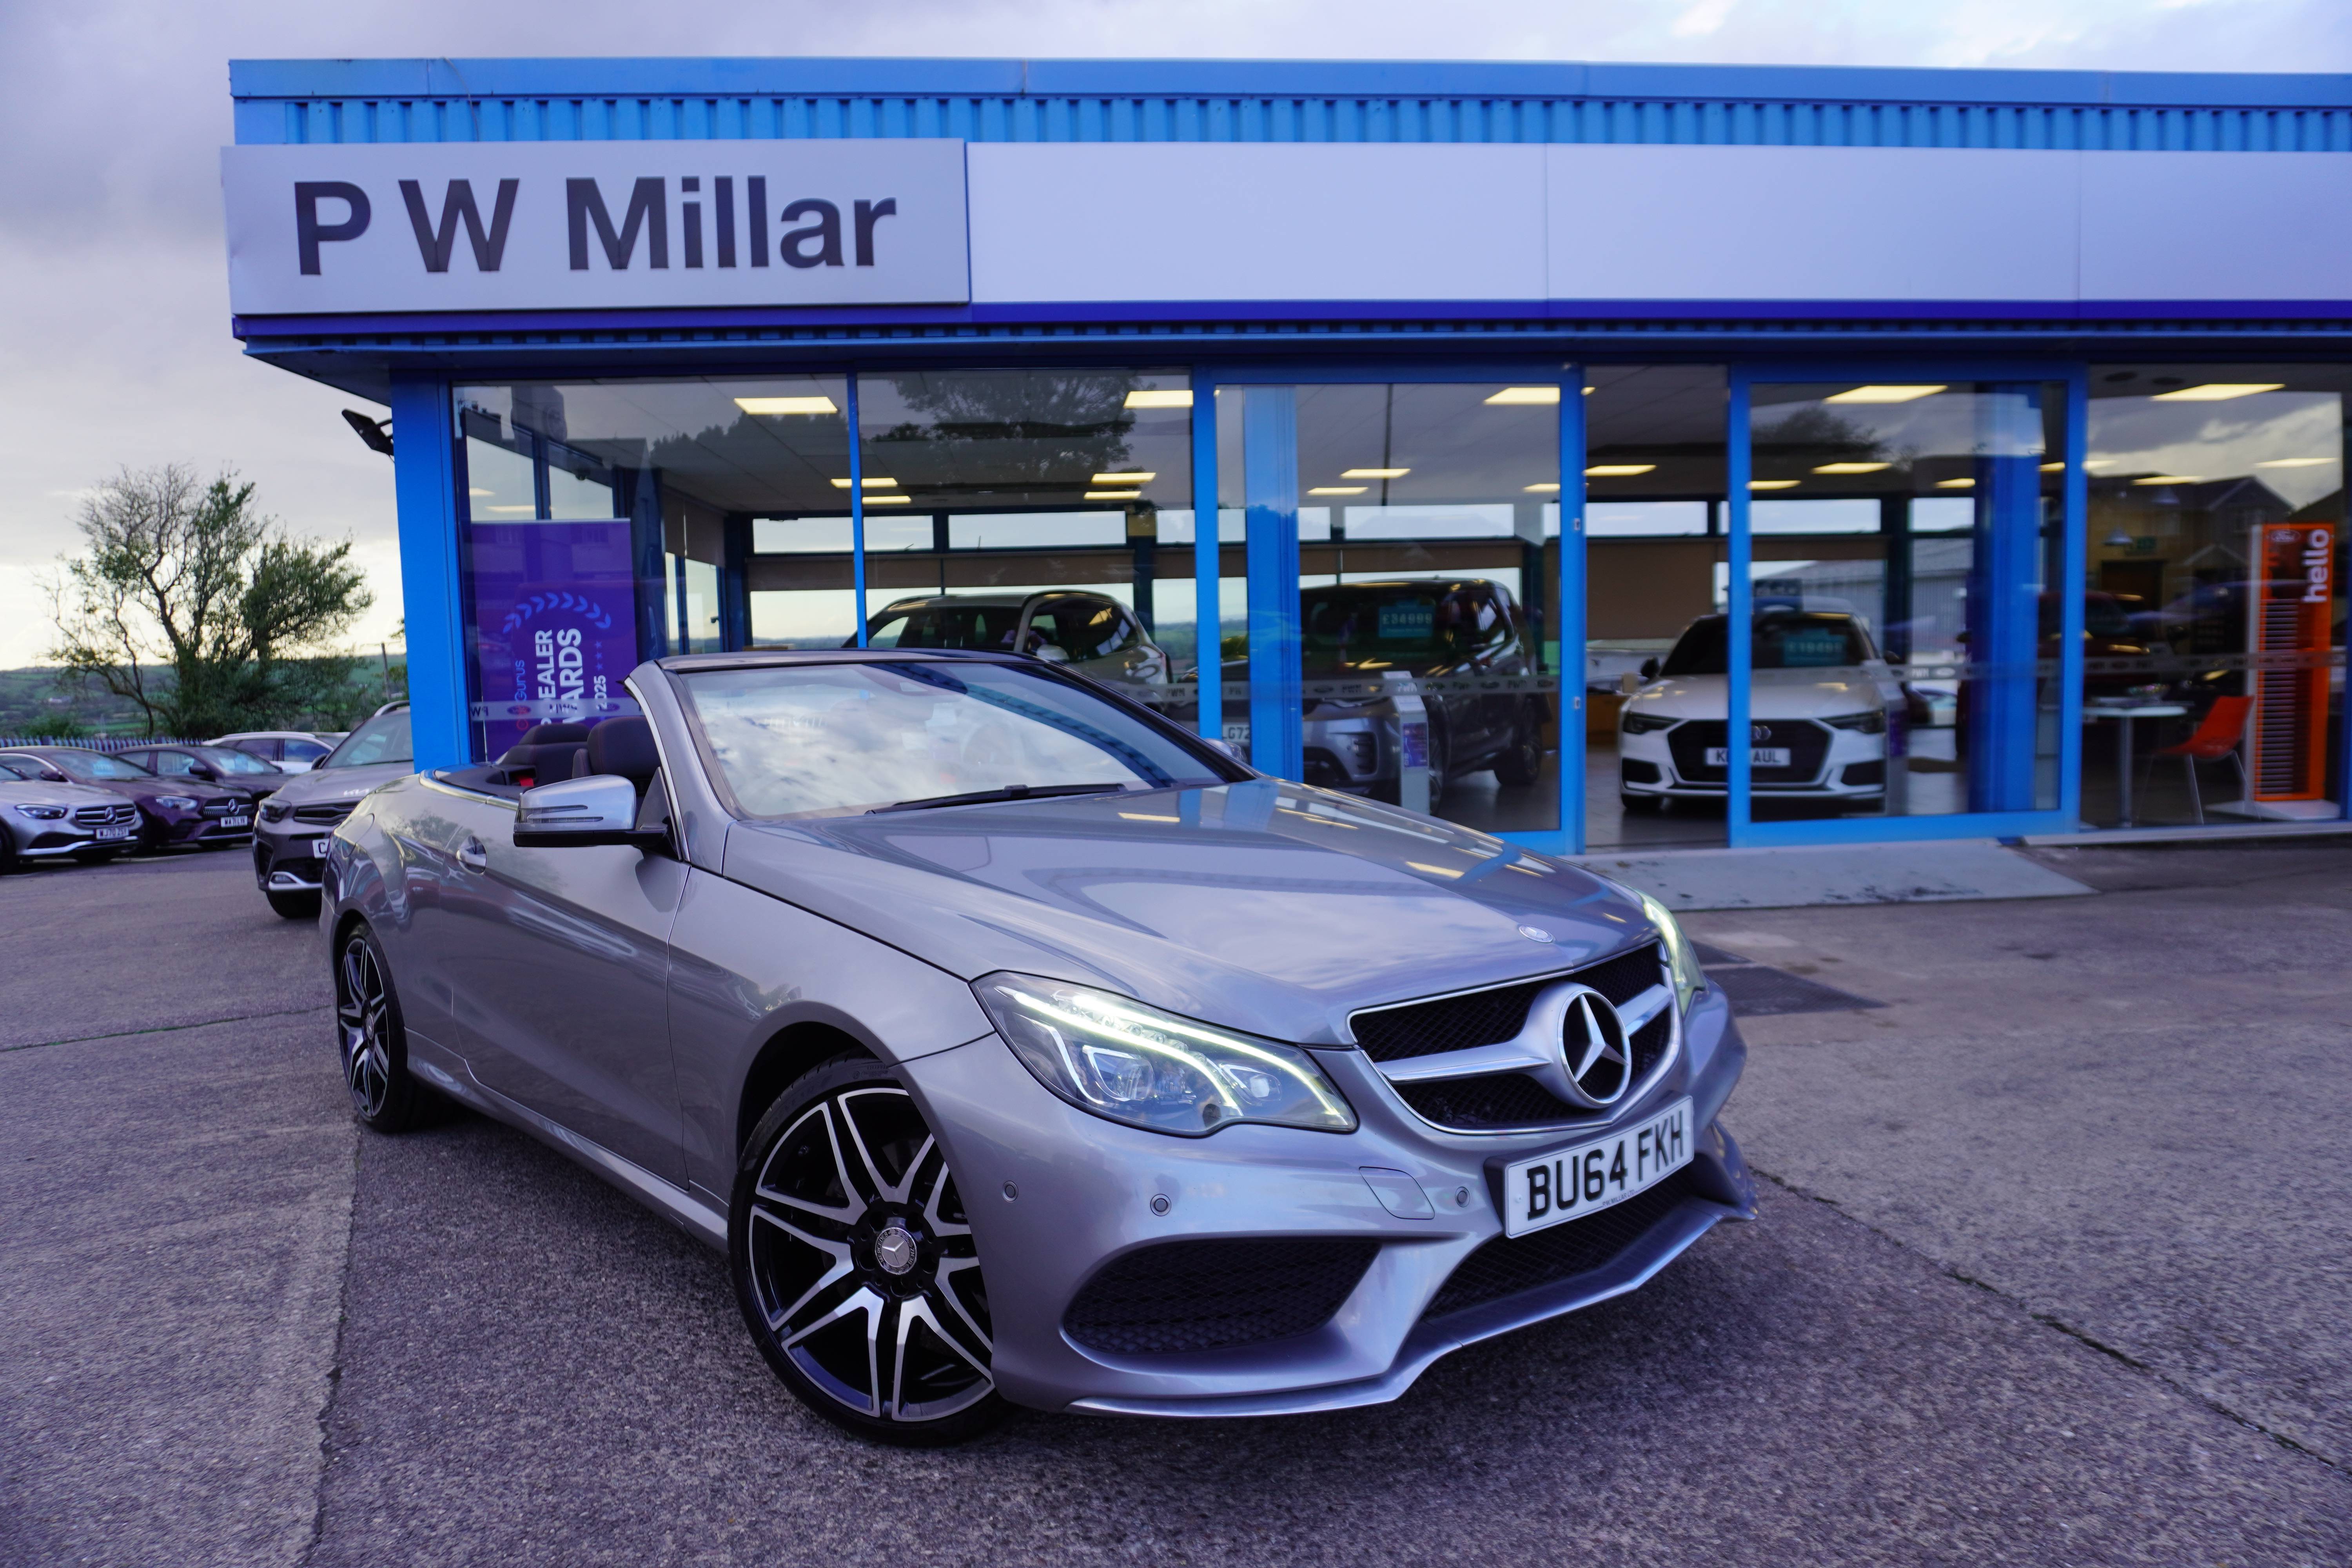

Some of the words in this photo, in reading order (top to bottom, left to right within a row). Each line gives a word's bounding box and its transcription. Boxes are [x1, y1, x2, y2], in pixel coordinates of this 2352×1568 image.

[294, 181, 372, 275] P
[398, 178, 519, 273] W
[566, 175, 896, 271] Millar
[2301, 529, 2329, 602] hello
[535, 629, 556, 701] EALER
[1527, 1140, 1628, 1221] BU64
[1638, 1110, 1684, 1183] FKH
[877, 1232, 889, 1262] MERCEDES
